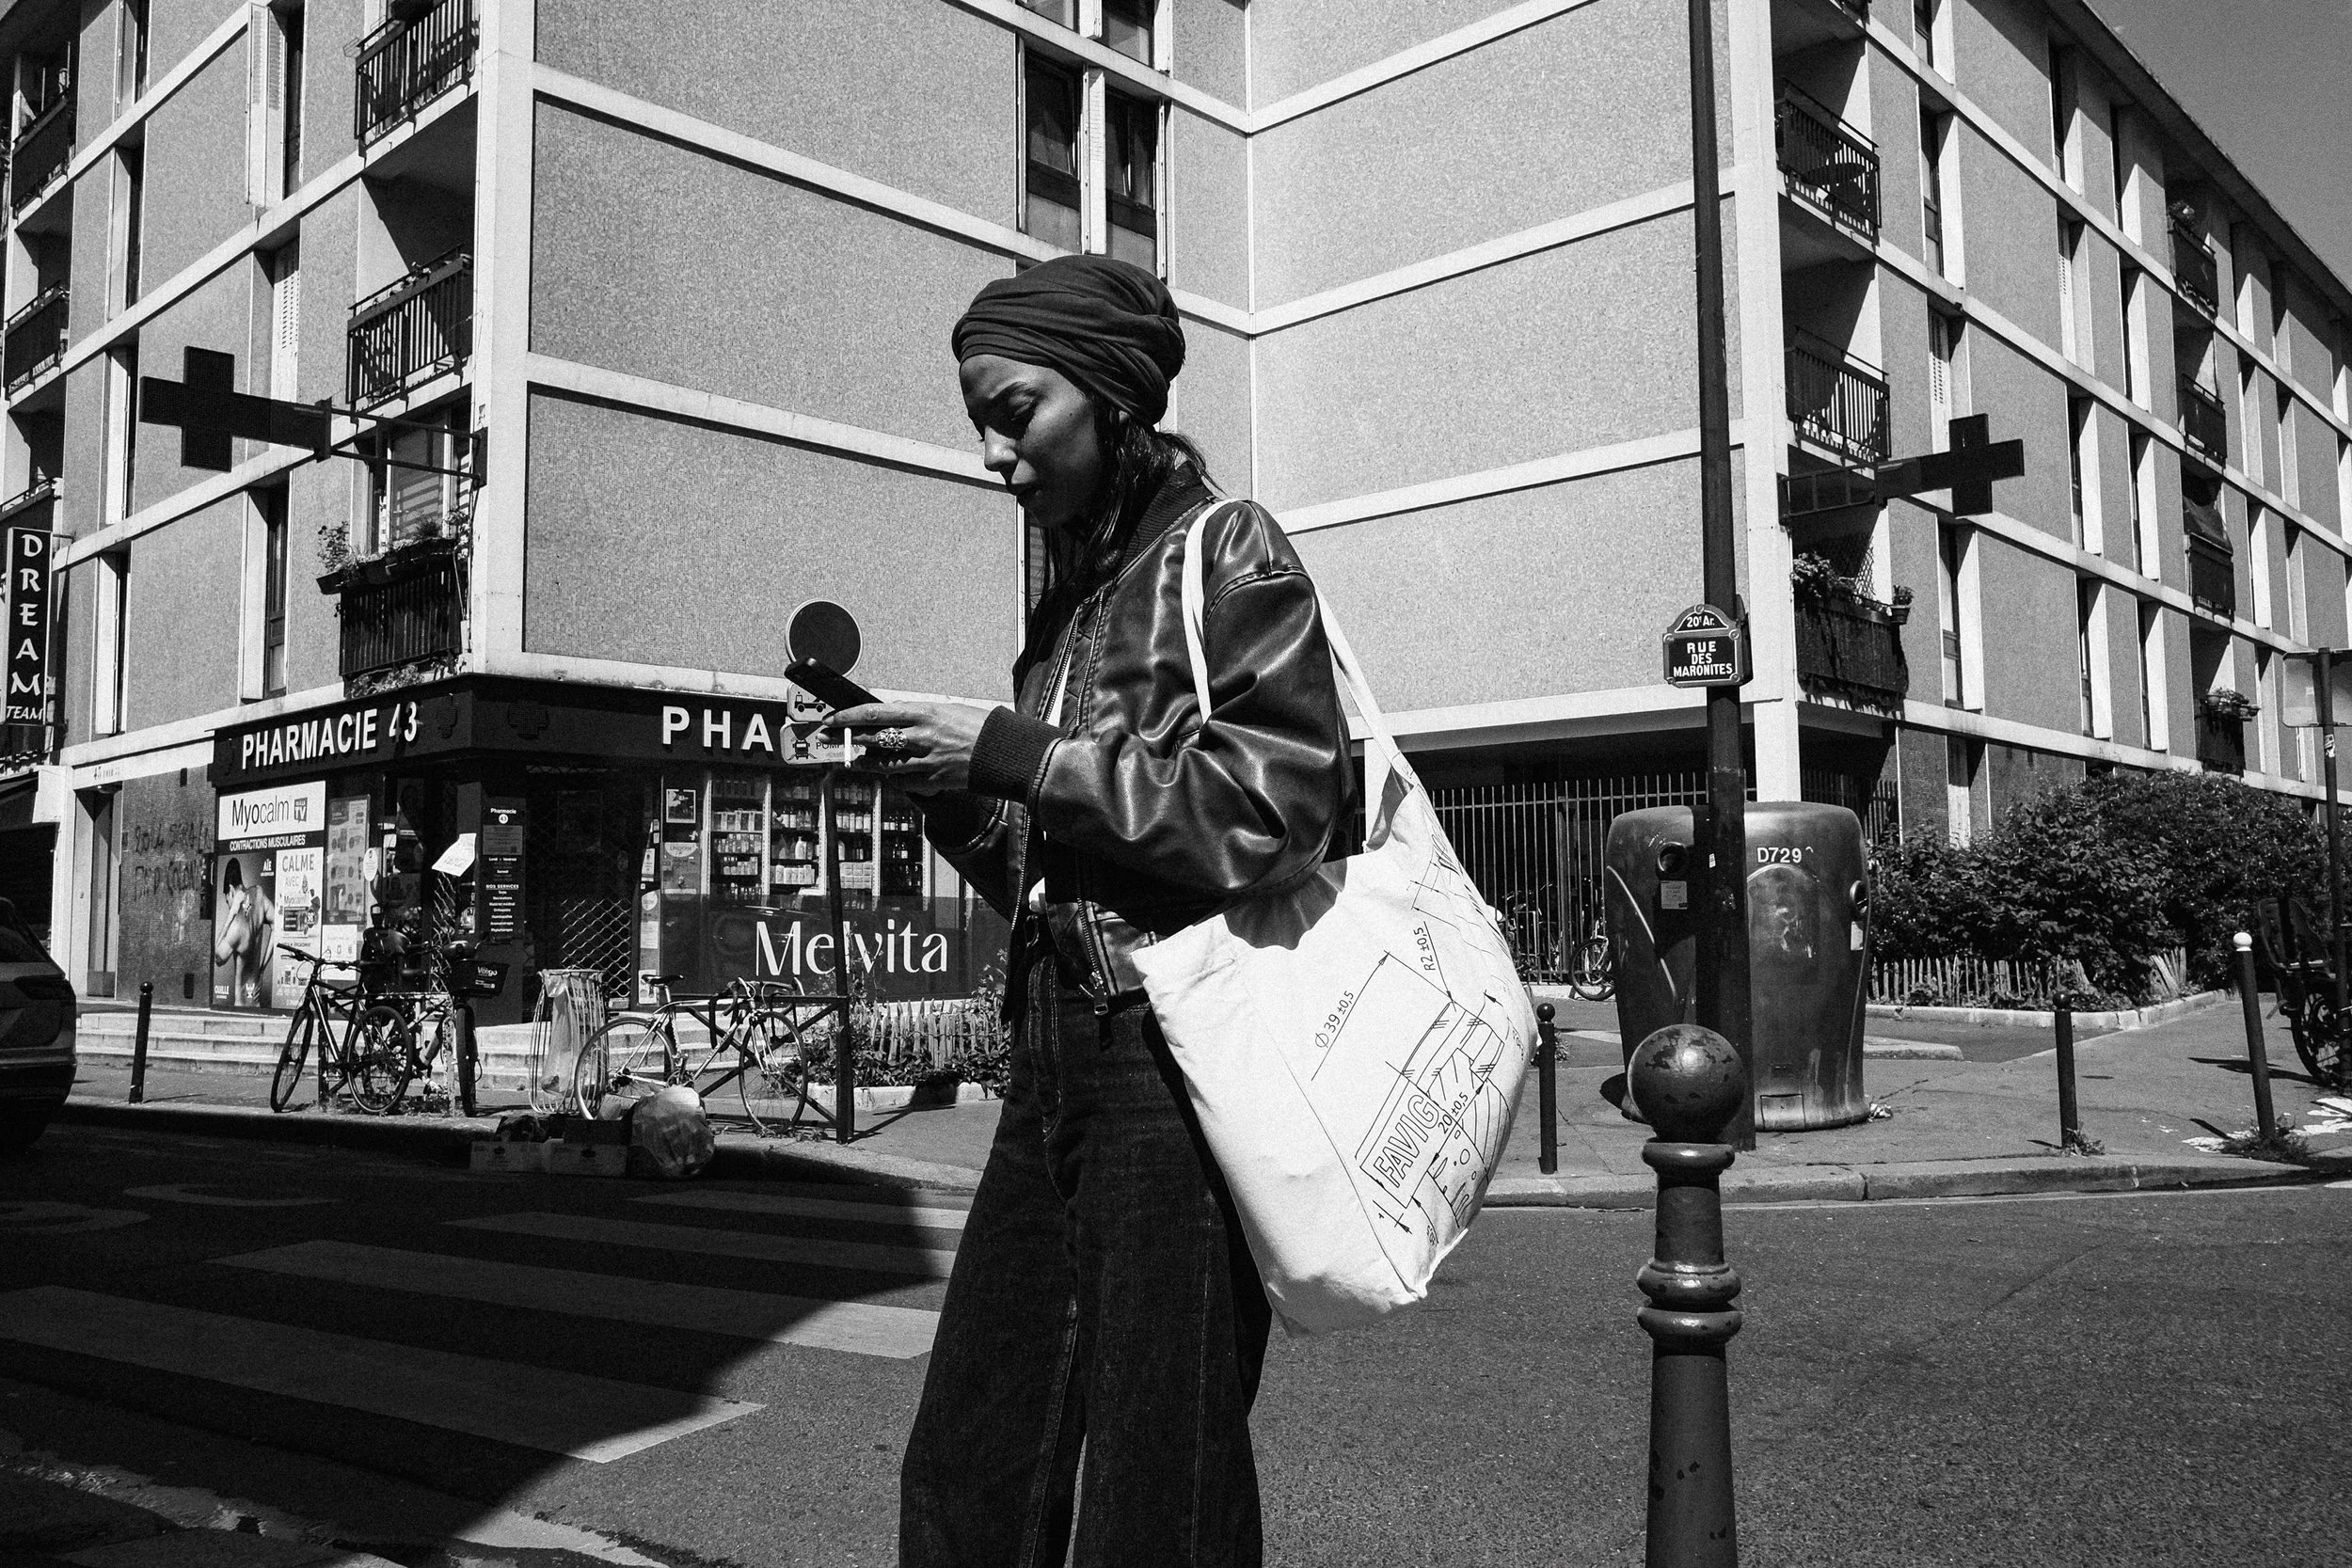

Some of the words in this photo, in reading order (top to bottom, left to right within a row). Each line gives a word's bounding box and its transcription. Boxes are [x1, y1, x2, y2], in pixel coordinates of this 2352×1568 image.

[10, 533, 43, 696] DREAM
[1687, 641, 1717, 654] RUE
[1692, 653, 1712, 665] DES
[1673, 663, 1733, 677] MARONITES
[6, 705, 43, 721] TEAM
[242, 708, 377, 769] PHARMACIE
[389, 701, 418, 743] 43
[231, 795, 289, 833] Myocalm
[230, 837, 268, 852] CONTRACTIONS
[268, 834, 307, 847] MUSCULAIRES
[282, 854, 314, 873] CALME
[1756, 847, 1803, 863] D729
[755, 918, 947, 976] Melvita
[1421, 955, 1436, 971] R2
[1324, 1013, 1341, 1034] 39
[1438, 1114, 1453, 1134] 20
